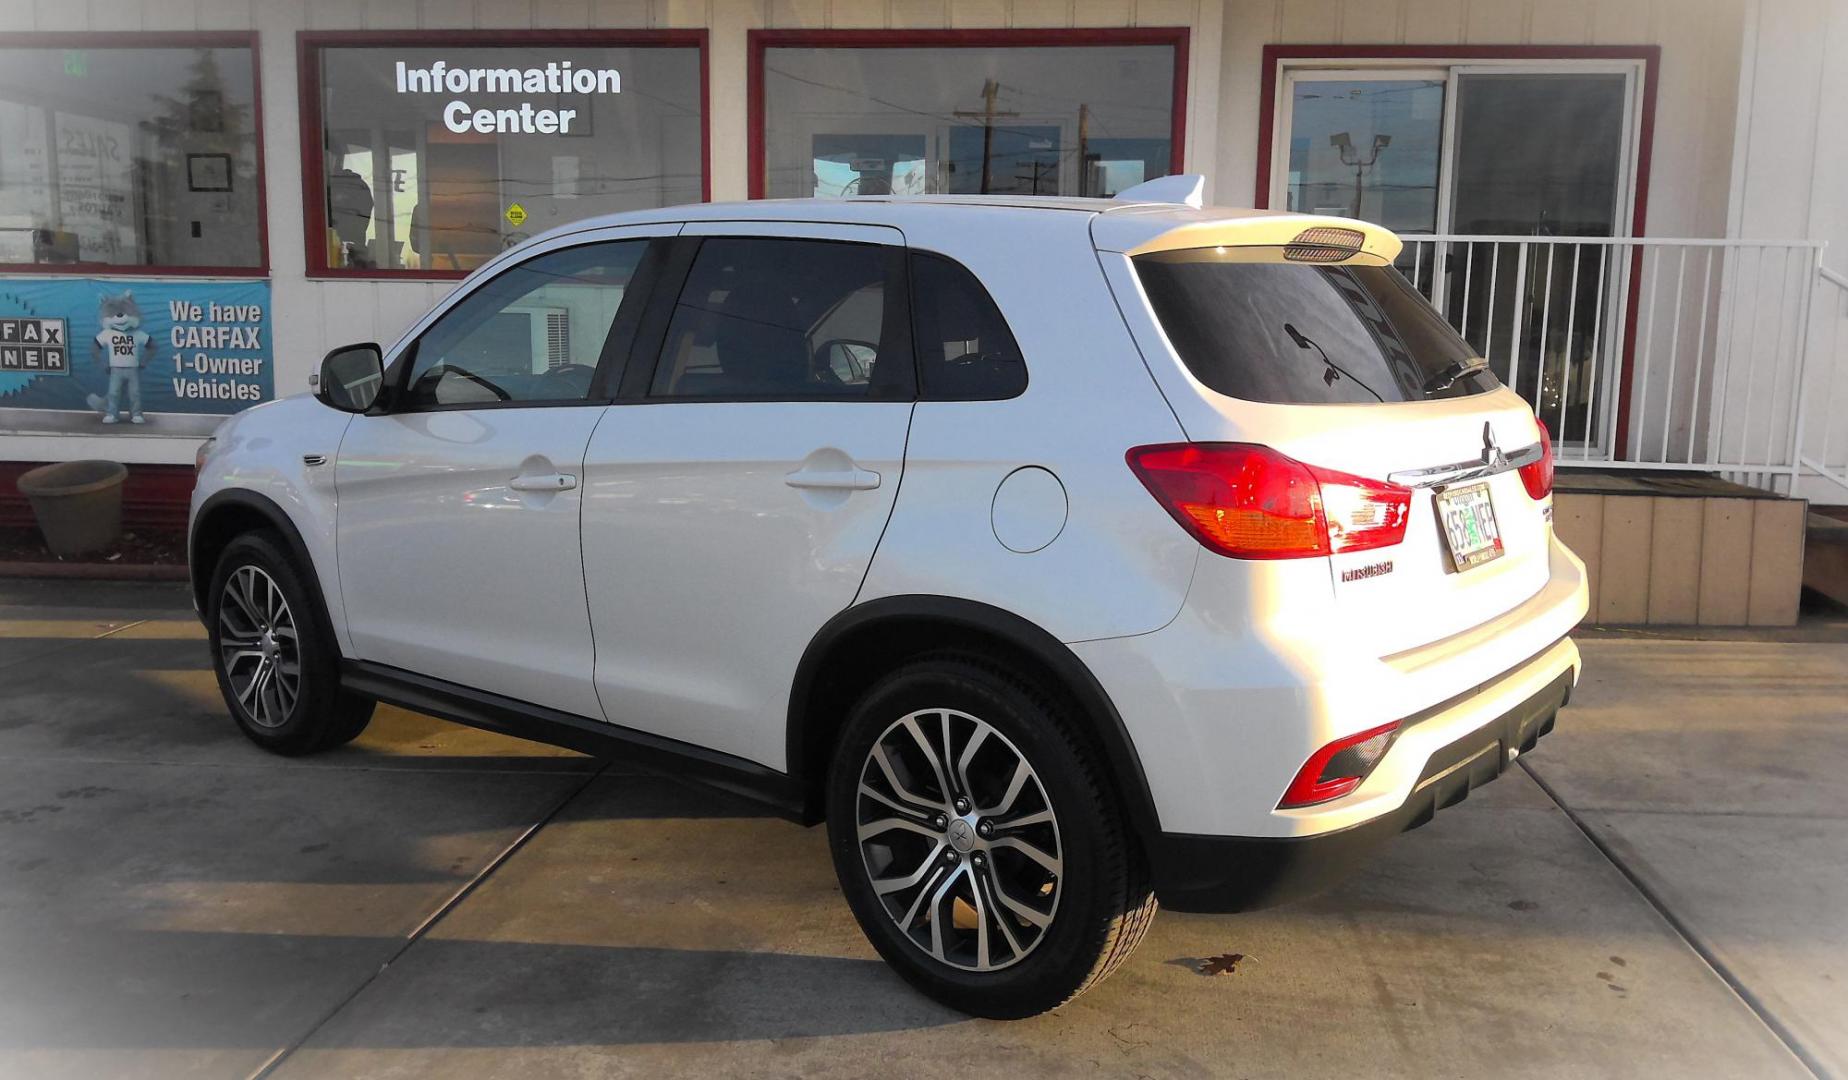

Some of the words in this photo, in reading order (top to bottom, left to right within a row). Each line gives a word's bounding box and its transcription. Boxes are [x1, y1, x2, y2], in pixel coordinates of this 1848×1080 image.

[396, 60, 622, 94] Information
[443, 100, 577, 134] Center
[170, 300, 203, 321] We
[209, 301, 262, 322] have
[2, 320, 64, 345] FAX
[111, 335, 134, 346] CAR
[170, 325, 262, 350] CARFAX
[4, 350, 62, 368] NER
[113, 345, 134, 356] FOX
[172, 352, 263, 375] 1-Owner
[172, 377, 262, 401] Vehicles
